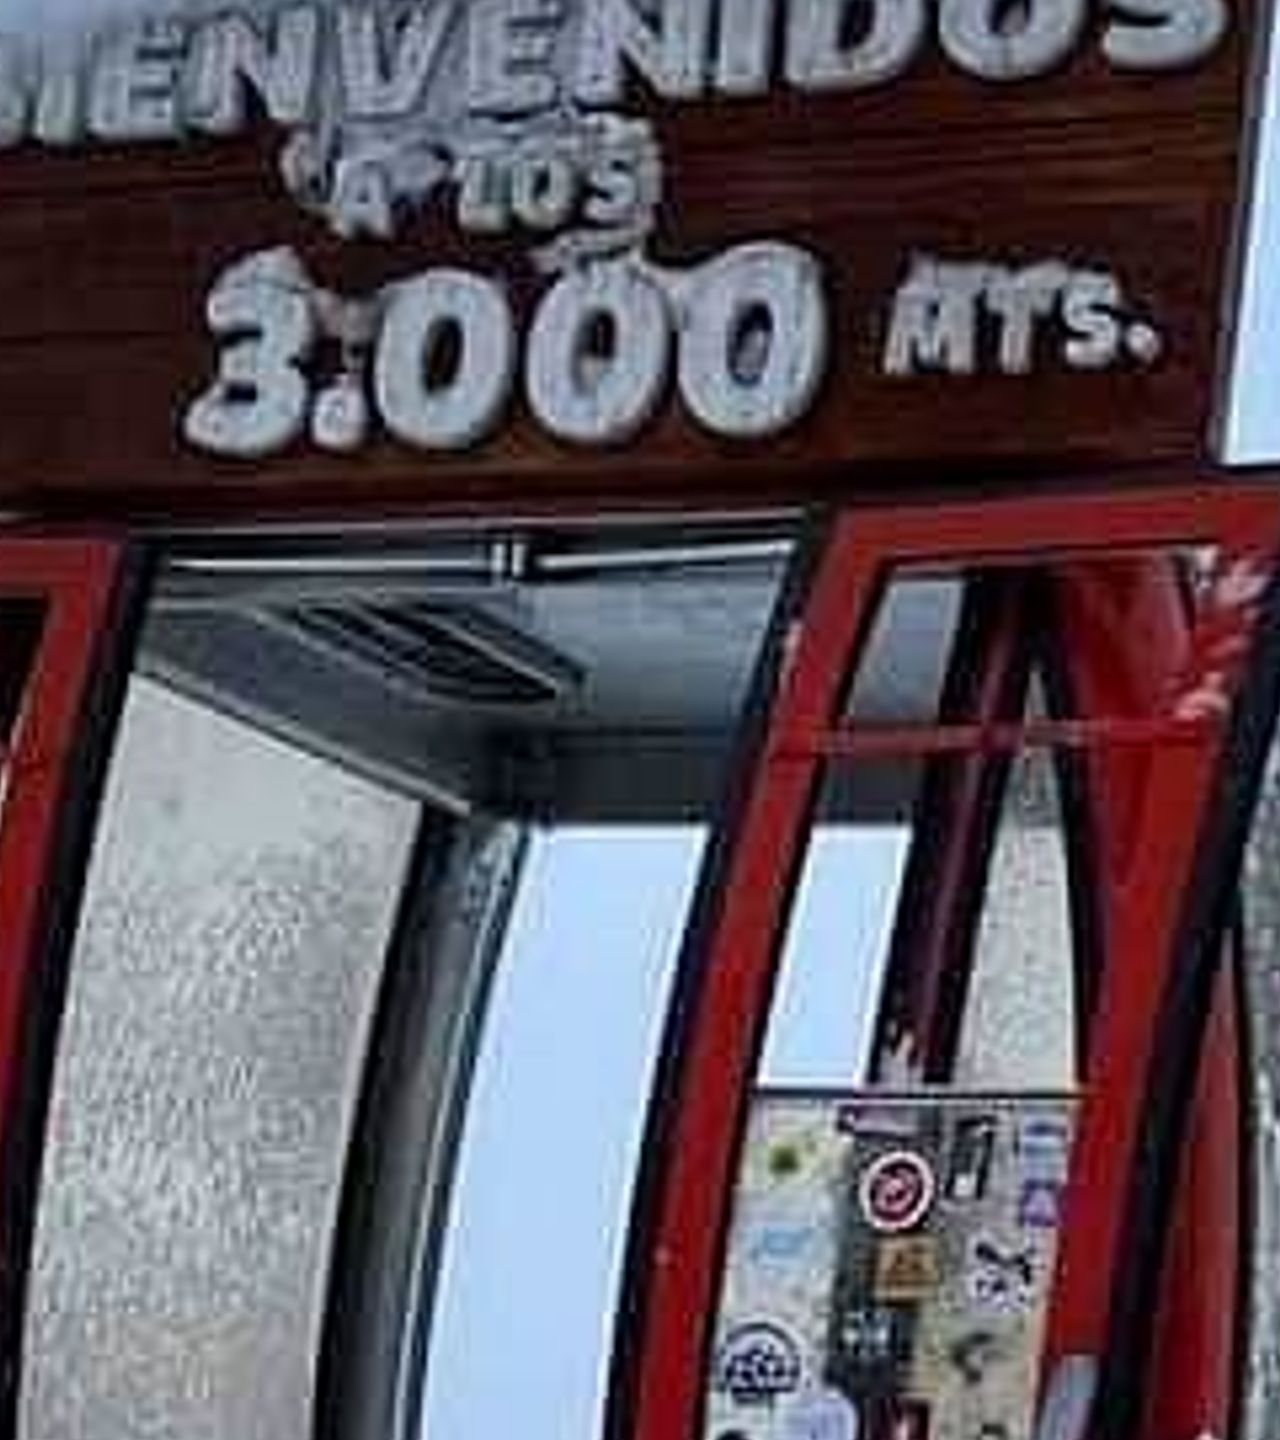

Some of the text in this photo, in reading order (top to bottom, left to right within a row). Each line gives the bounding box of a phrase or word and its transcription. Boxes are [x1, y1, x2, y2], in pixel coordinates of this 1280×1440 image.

[330, 152, 658, 240] A LOS
[184, 245, 824, 454] 3.000
